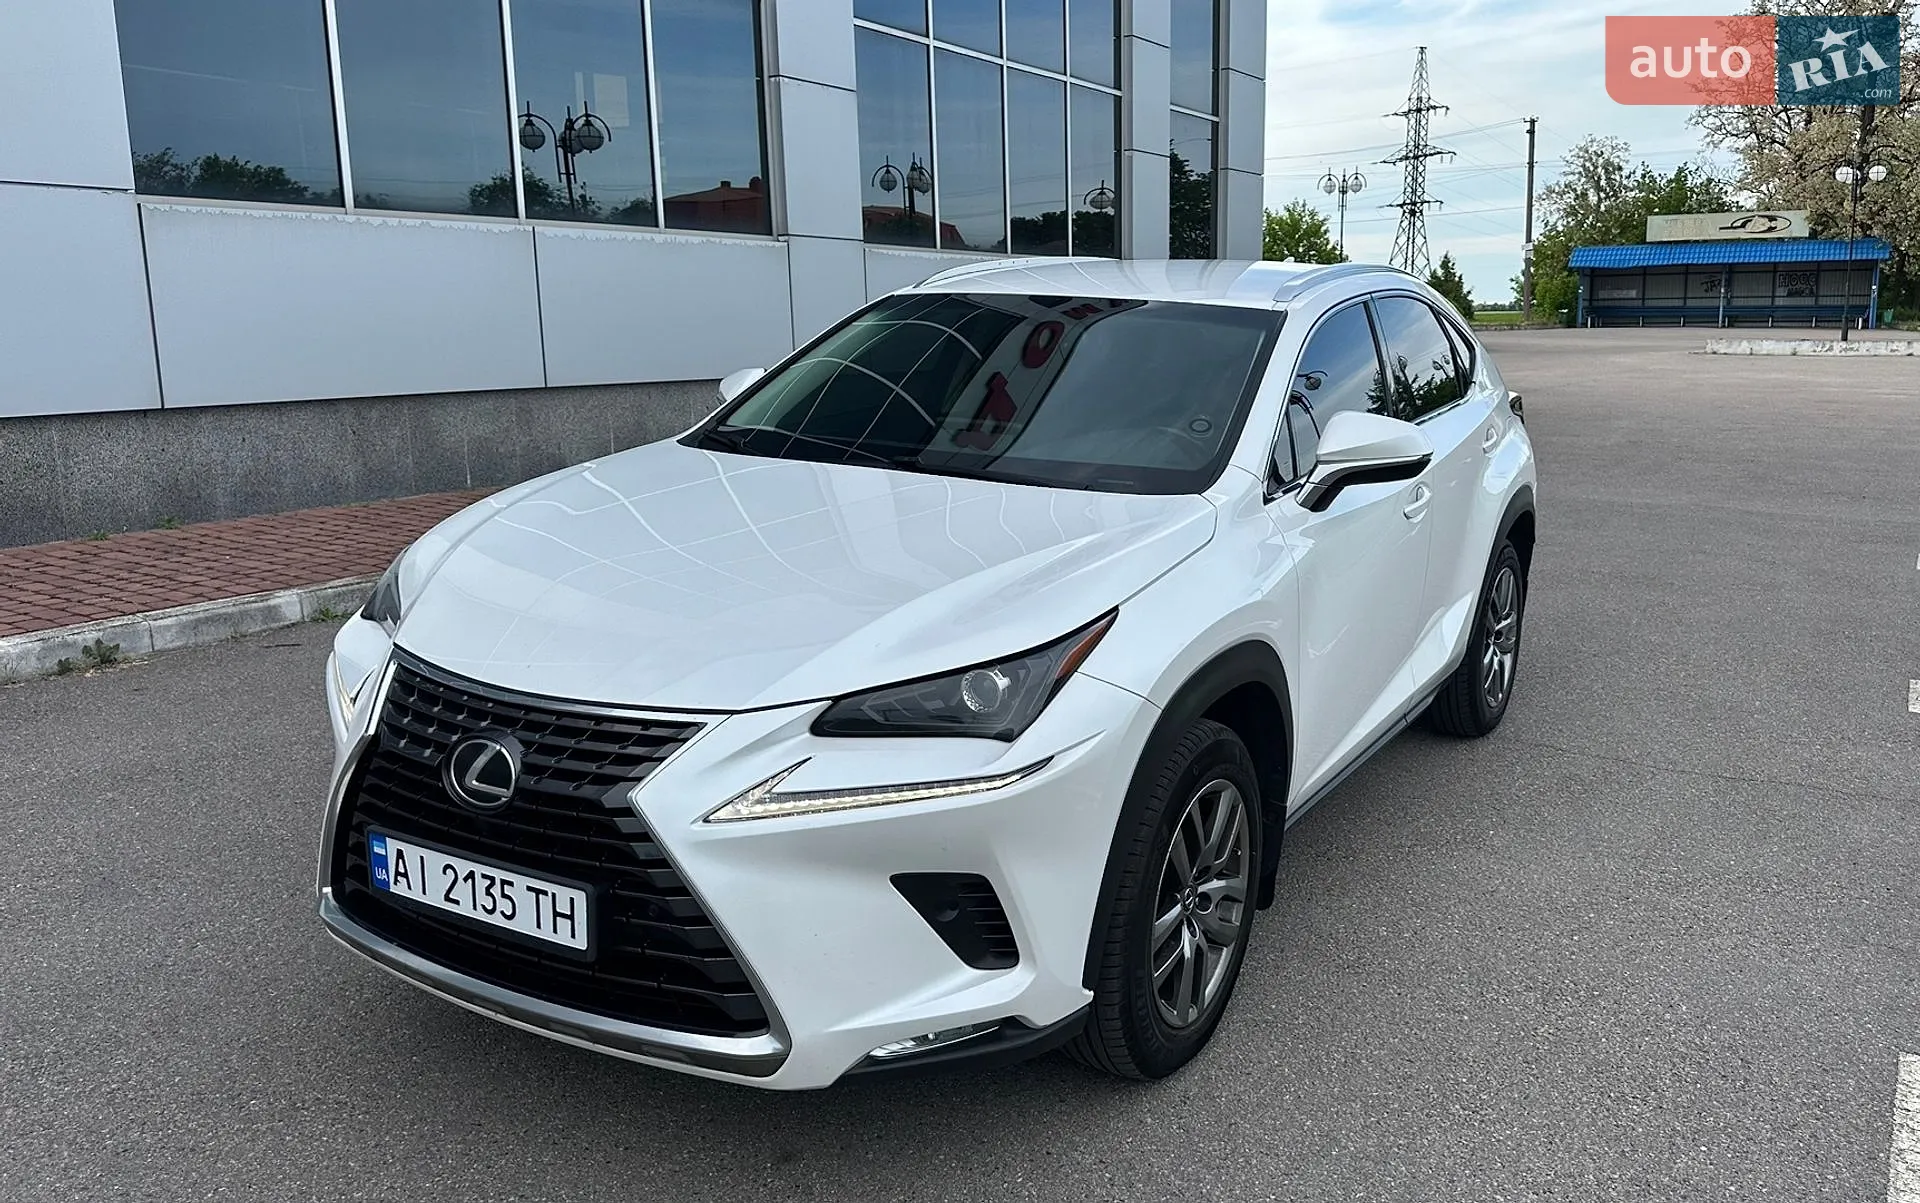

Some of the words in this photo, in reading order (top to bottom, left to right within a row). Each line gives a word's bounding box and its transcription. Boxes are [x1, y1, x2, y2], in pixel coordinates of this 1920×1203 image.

[375, 866, 389, 882] UA
[393, 846, 427, 896] AI
[441, 862, 517, 921] 2135
[525, 883, 577, 940] TH
